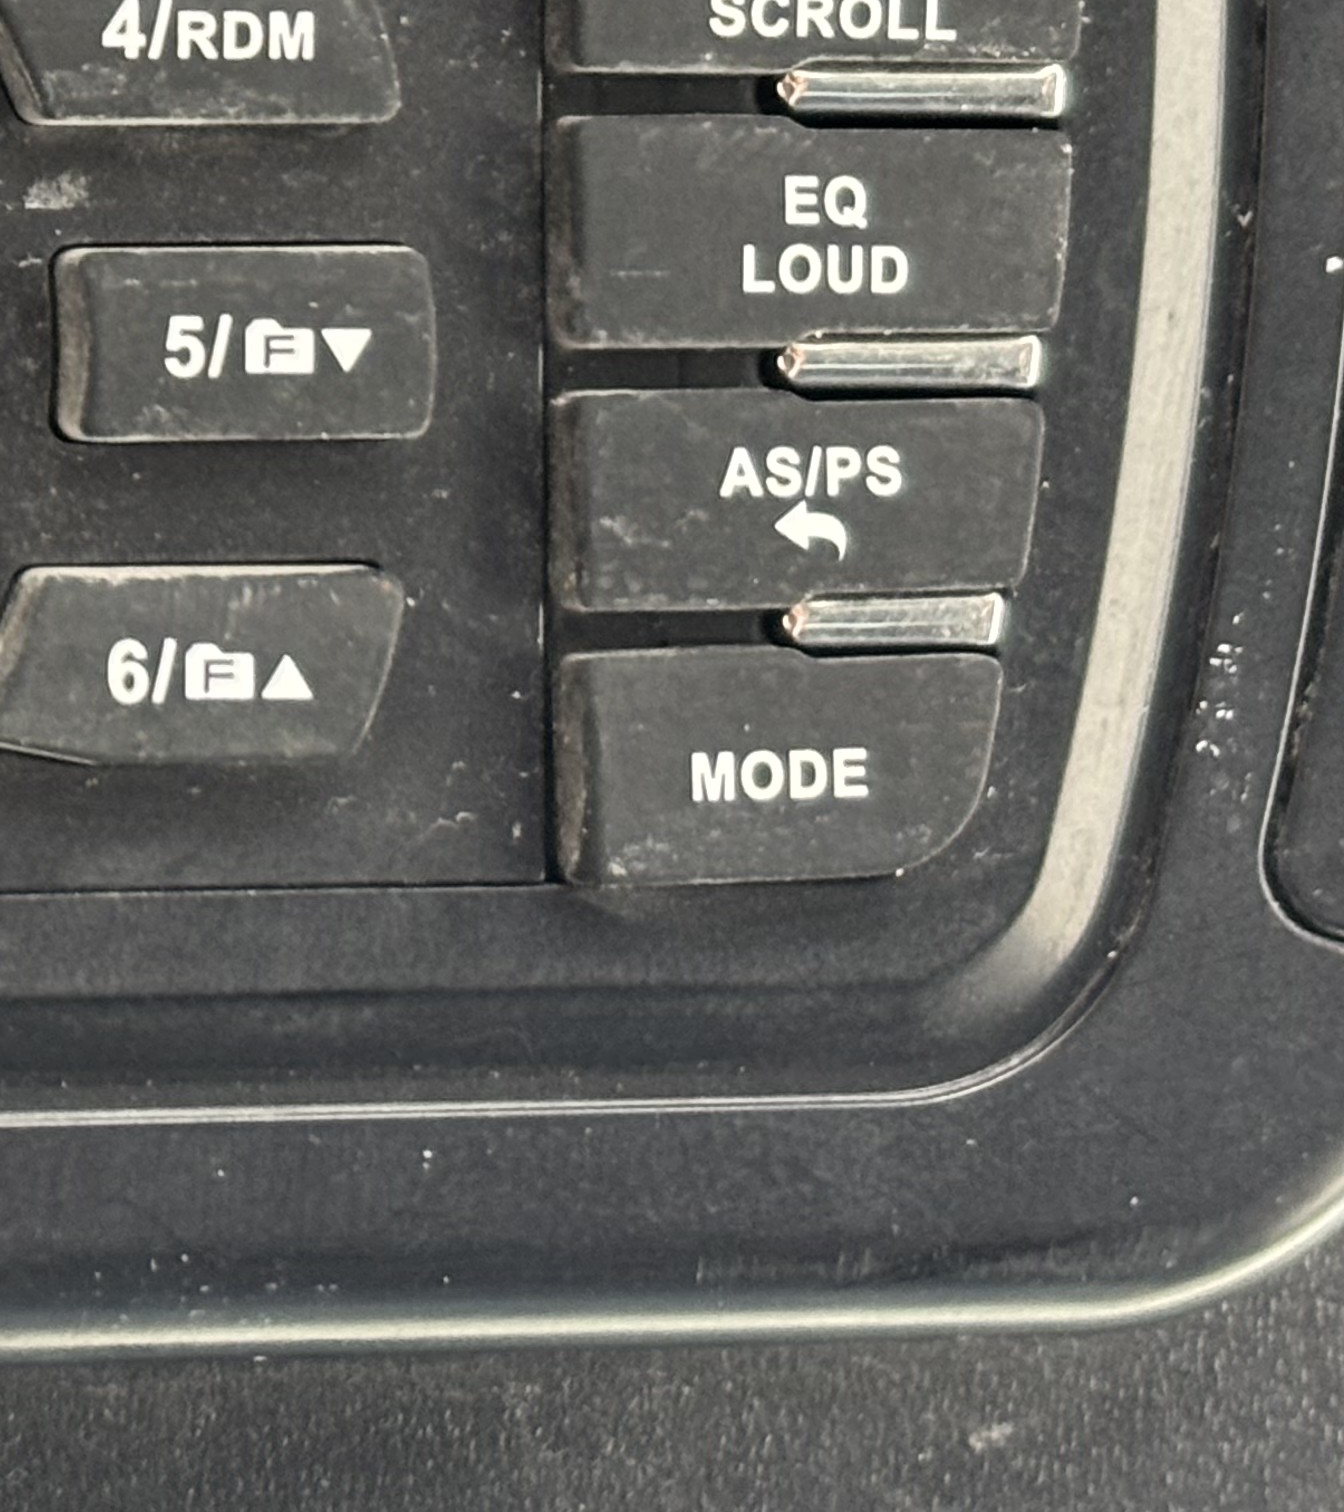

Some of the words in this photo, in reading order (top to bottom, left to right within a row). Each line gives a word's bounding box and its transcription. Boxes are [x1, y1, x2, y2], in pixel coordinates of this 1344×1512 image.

[783, 174, 869, 230] EQ
[741, 242, 910, 295] LOUD
[719, 445, 903, 499] AS/PS
[689, 746, 870, 803] MODE
